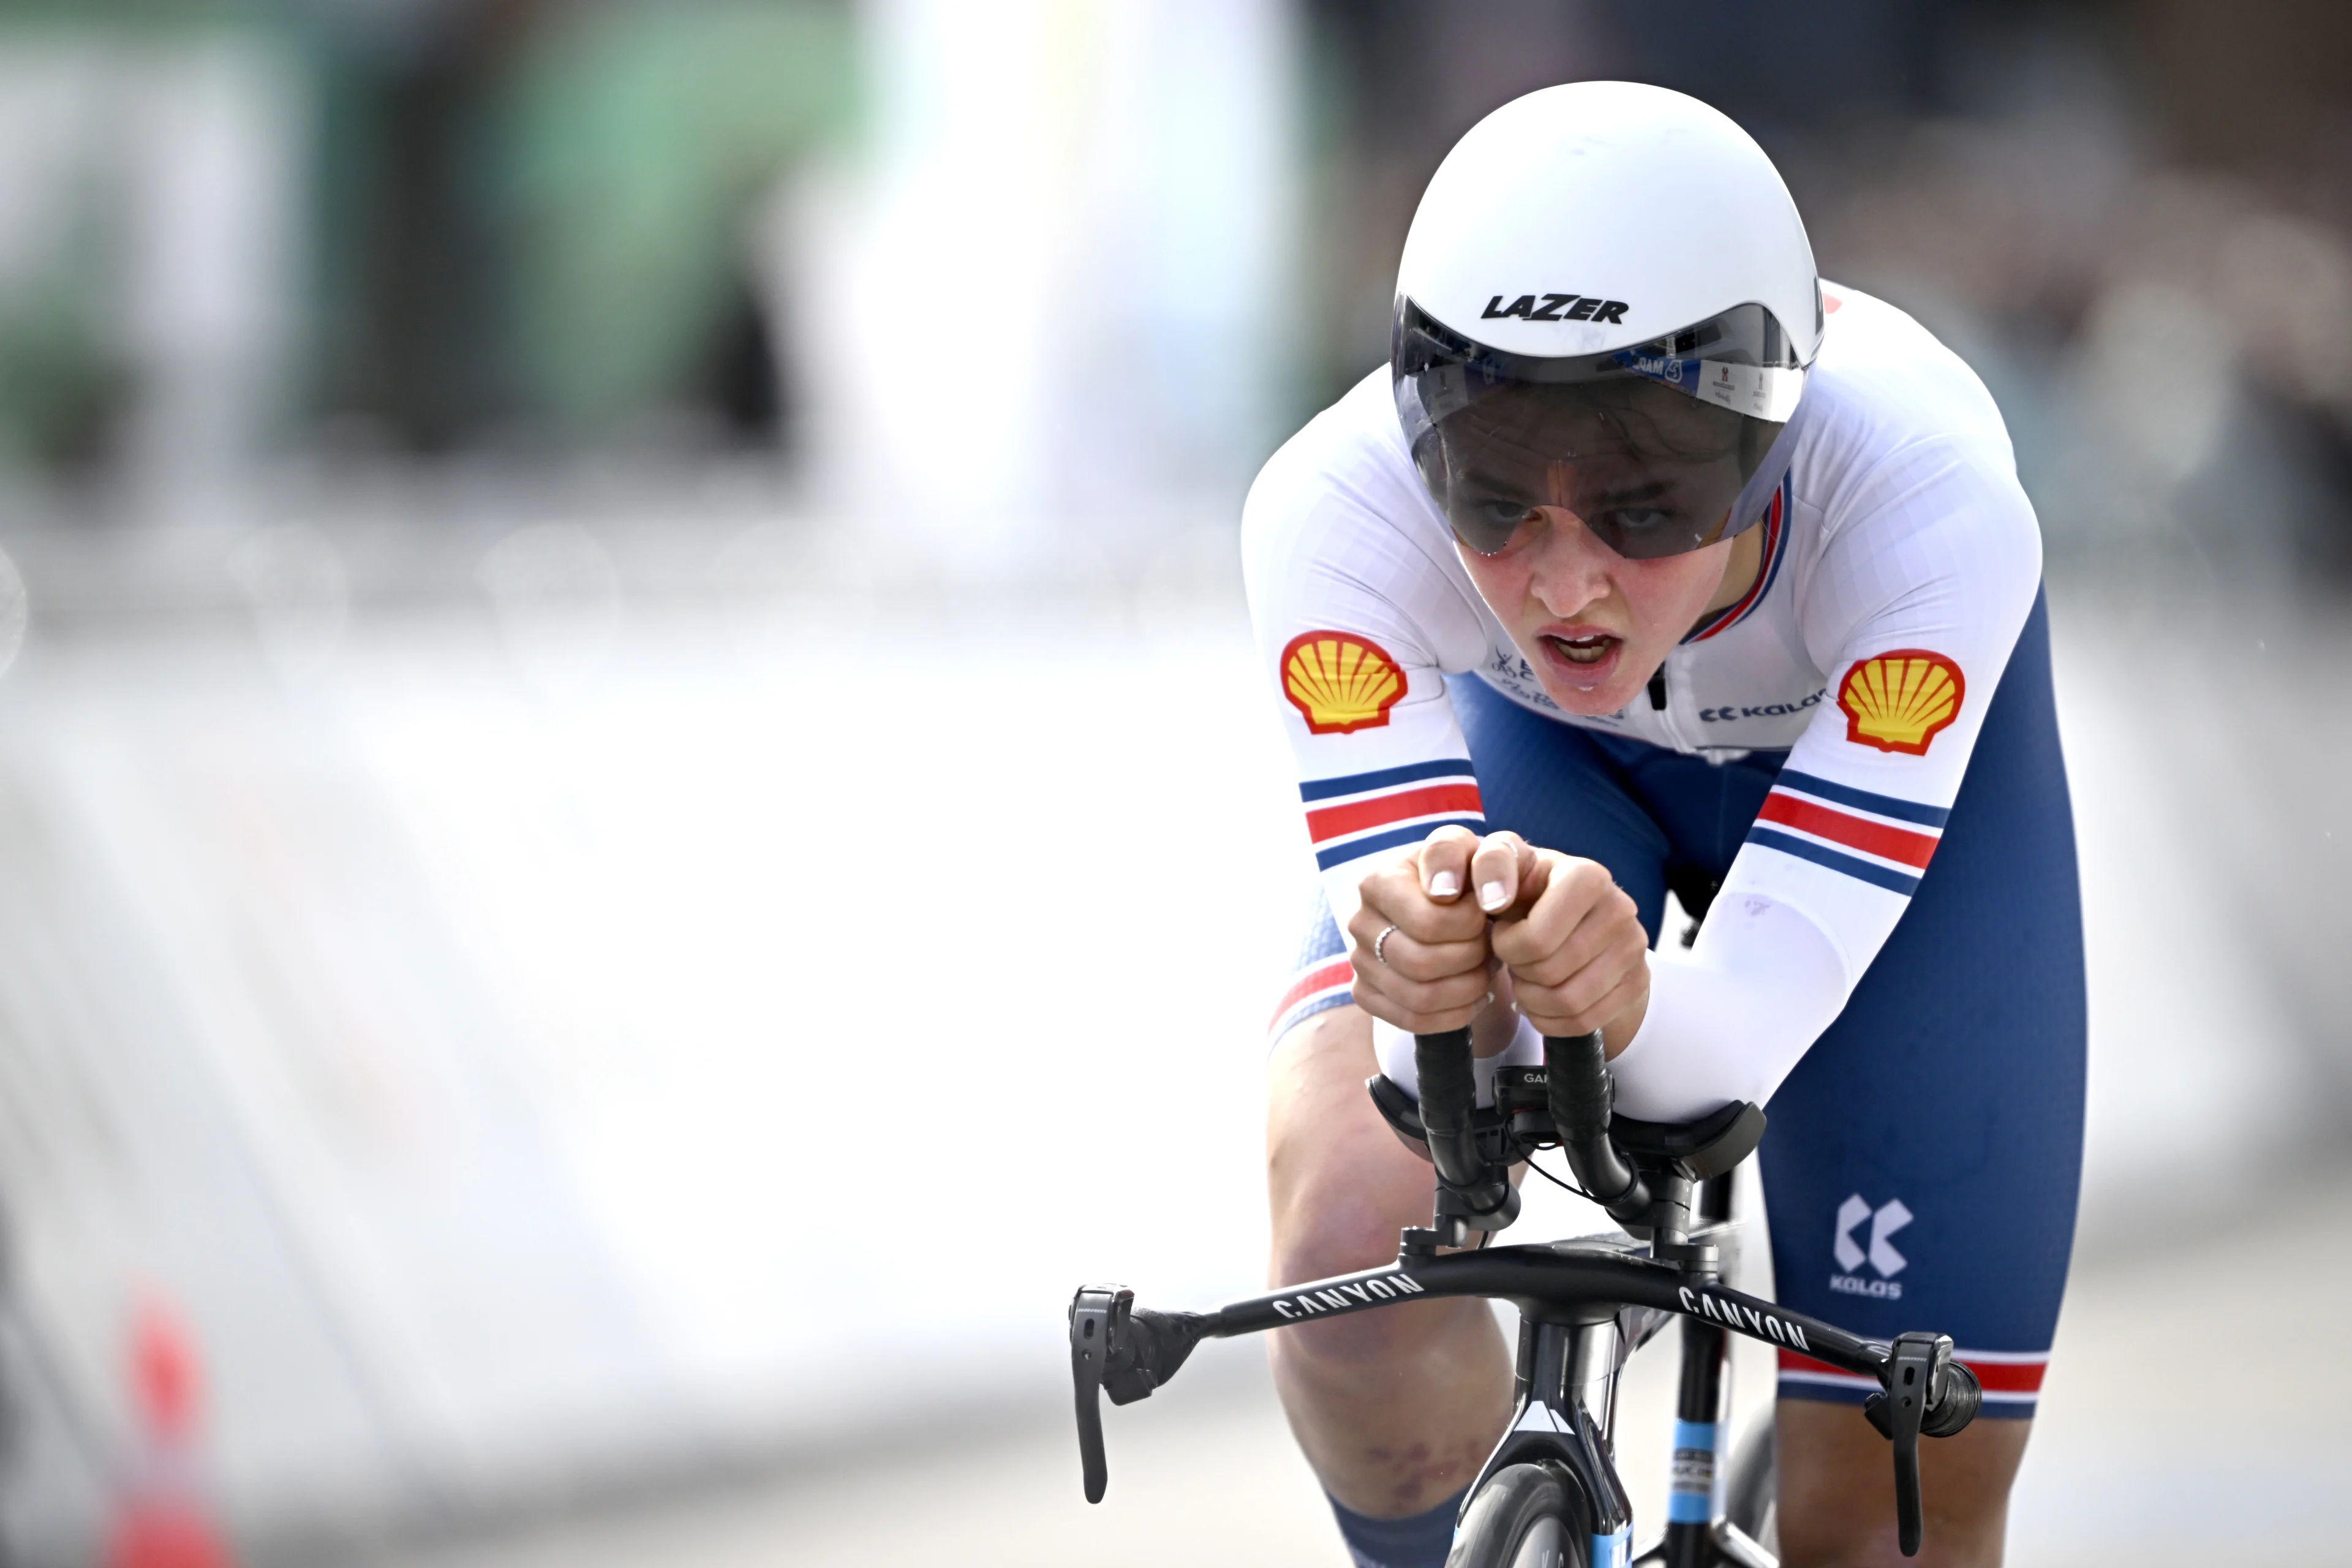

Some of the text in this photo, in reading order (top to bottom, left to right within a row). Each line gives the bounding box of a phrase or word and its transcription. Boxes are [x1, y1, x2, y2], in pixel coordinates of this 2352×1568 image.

[1480, 293, 1629, 324] LAZER
[1273, 1273, 1425, 1318] CANYON
[1679, 1286, 1811, 1351] CANYON
